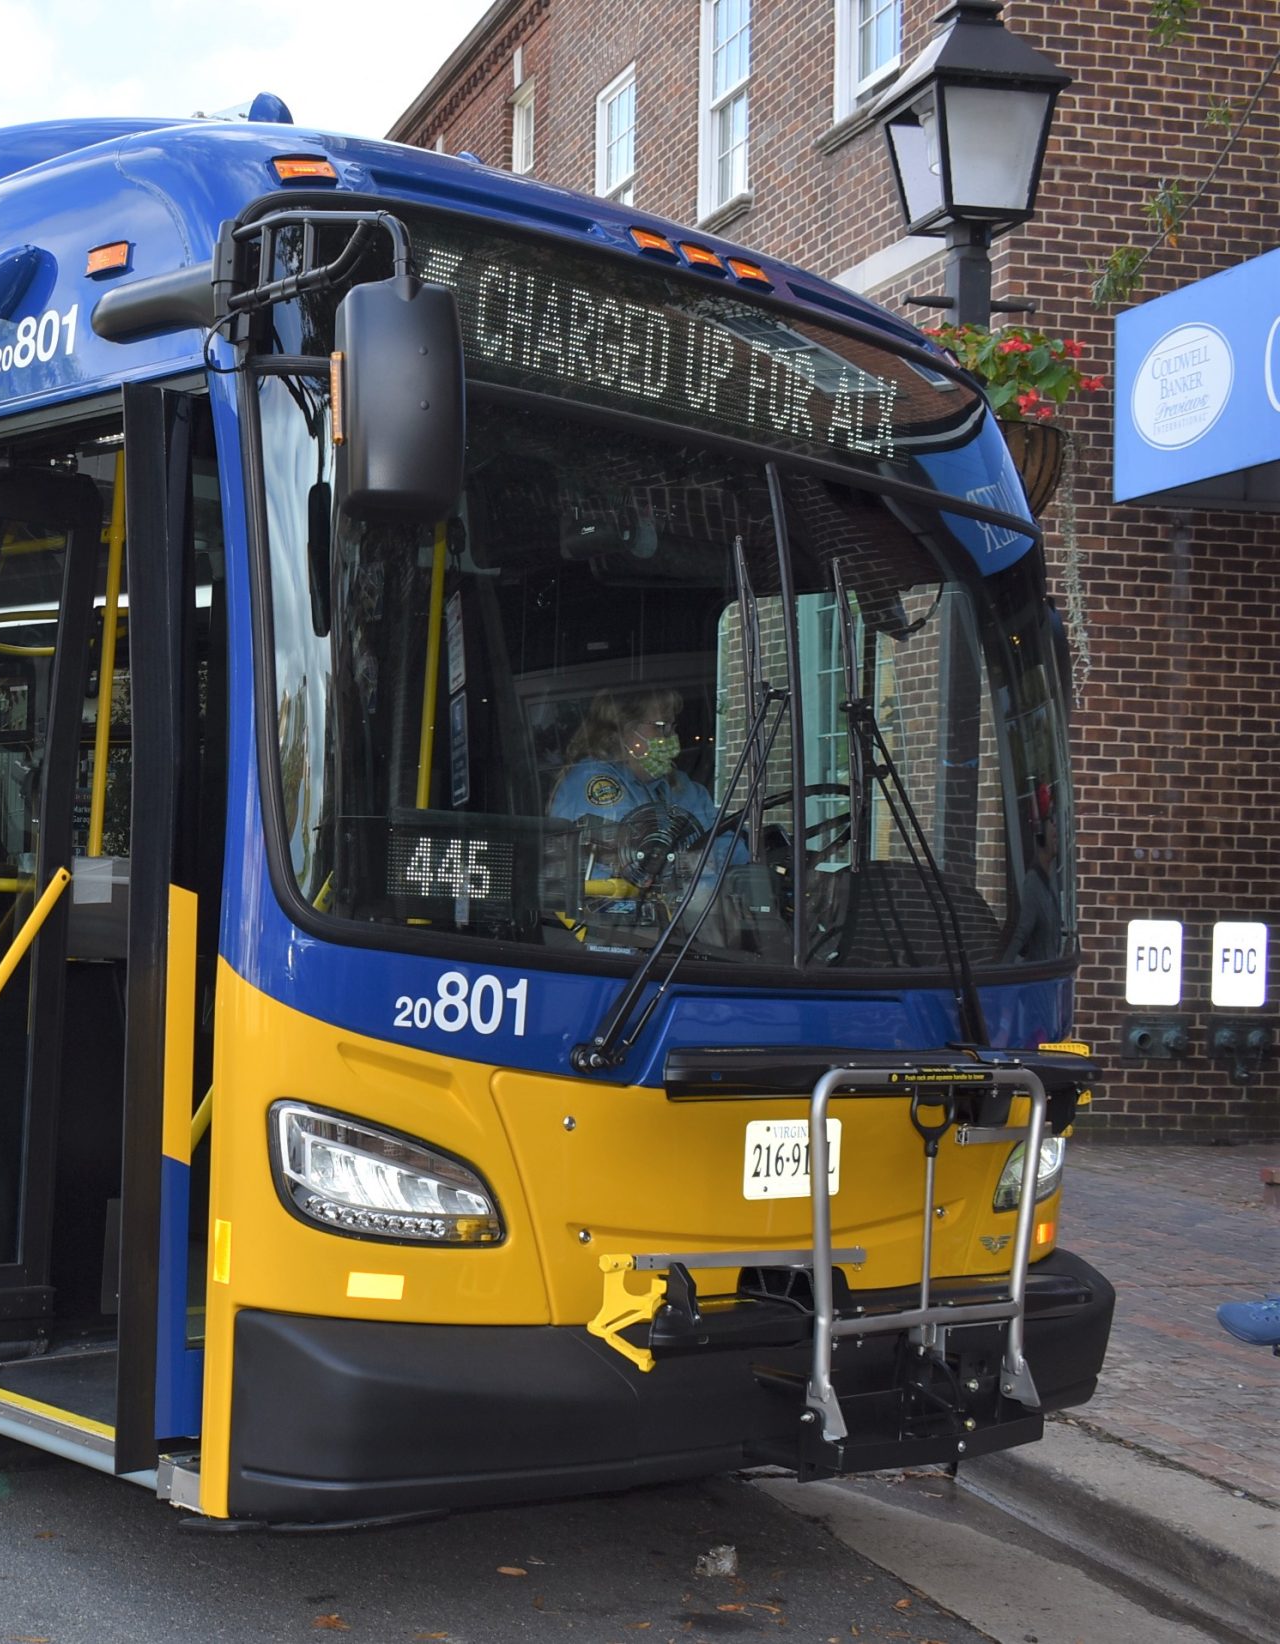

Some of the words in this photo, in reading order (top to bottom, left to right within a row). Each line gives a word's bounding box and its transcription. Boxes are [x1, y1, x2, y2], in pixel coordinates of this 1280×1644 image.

[477, 265, 670, 399] CHARGED
[685, 321, 734, 413] UP
[748, 339, 815, 438] FOR
[828, 366, 898, 458] ALX
[1152, 345, 1211, 380] COLDWELL
[1160, 371, 1203, 400] BANKER
[406, 837, 490, 899] 445
[1136, 946, 1172, 973] FDC
[1221, 948, 1257, 974] FDC
[393, 971, 528, 1036] 20801
[773, 1125, 808, 1139] VIRGIN
[751, 1141, 836, 1178] 216·91L
